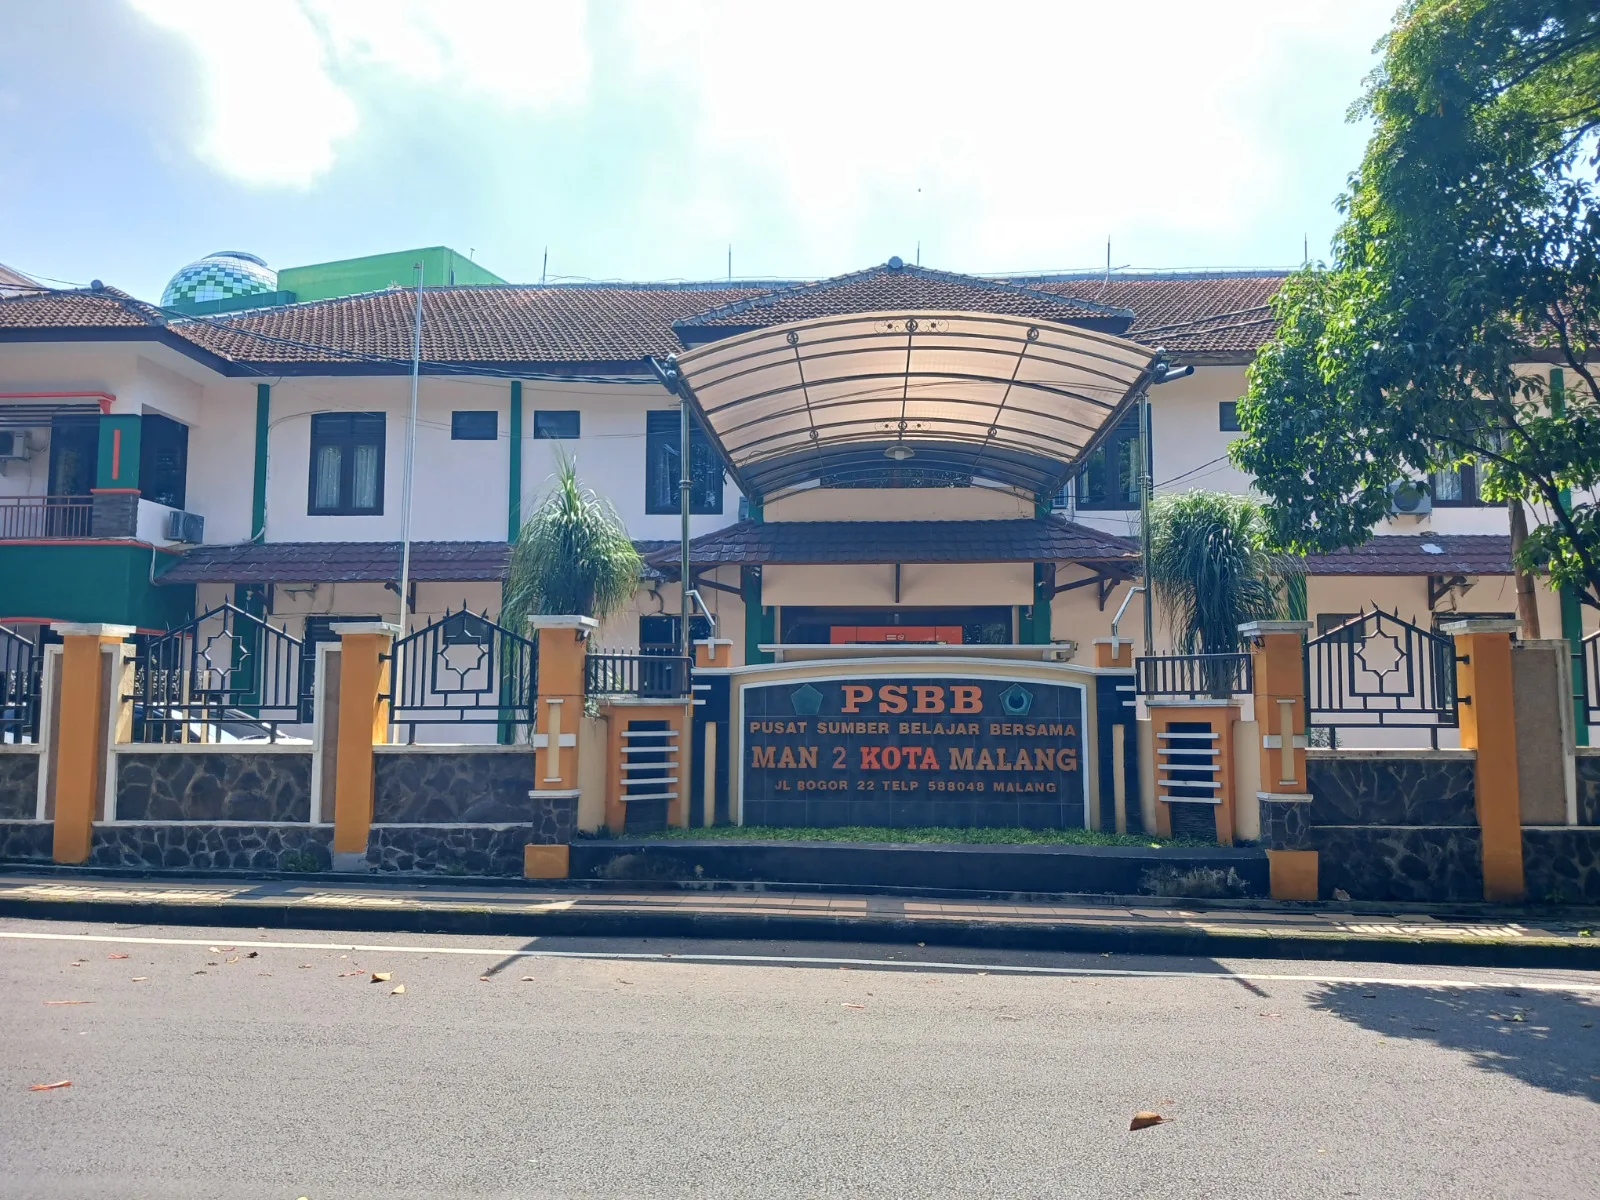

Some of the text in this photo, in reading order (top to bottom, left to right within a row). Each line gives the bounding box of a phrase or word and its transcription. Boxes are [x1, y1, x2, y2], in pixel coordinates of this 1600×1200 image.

[841, 685, 983, 714] PSBB
[750, 722, 1076, 737] PUSAT SUMBER BELAJAR BERSAMA
[752, 746, 1077, 771] MAN 2 KOTA MALANG
[774, 780, 1057, 793] JL BOGOR 22 TELP 588048 MALANG
